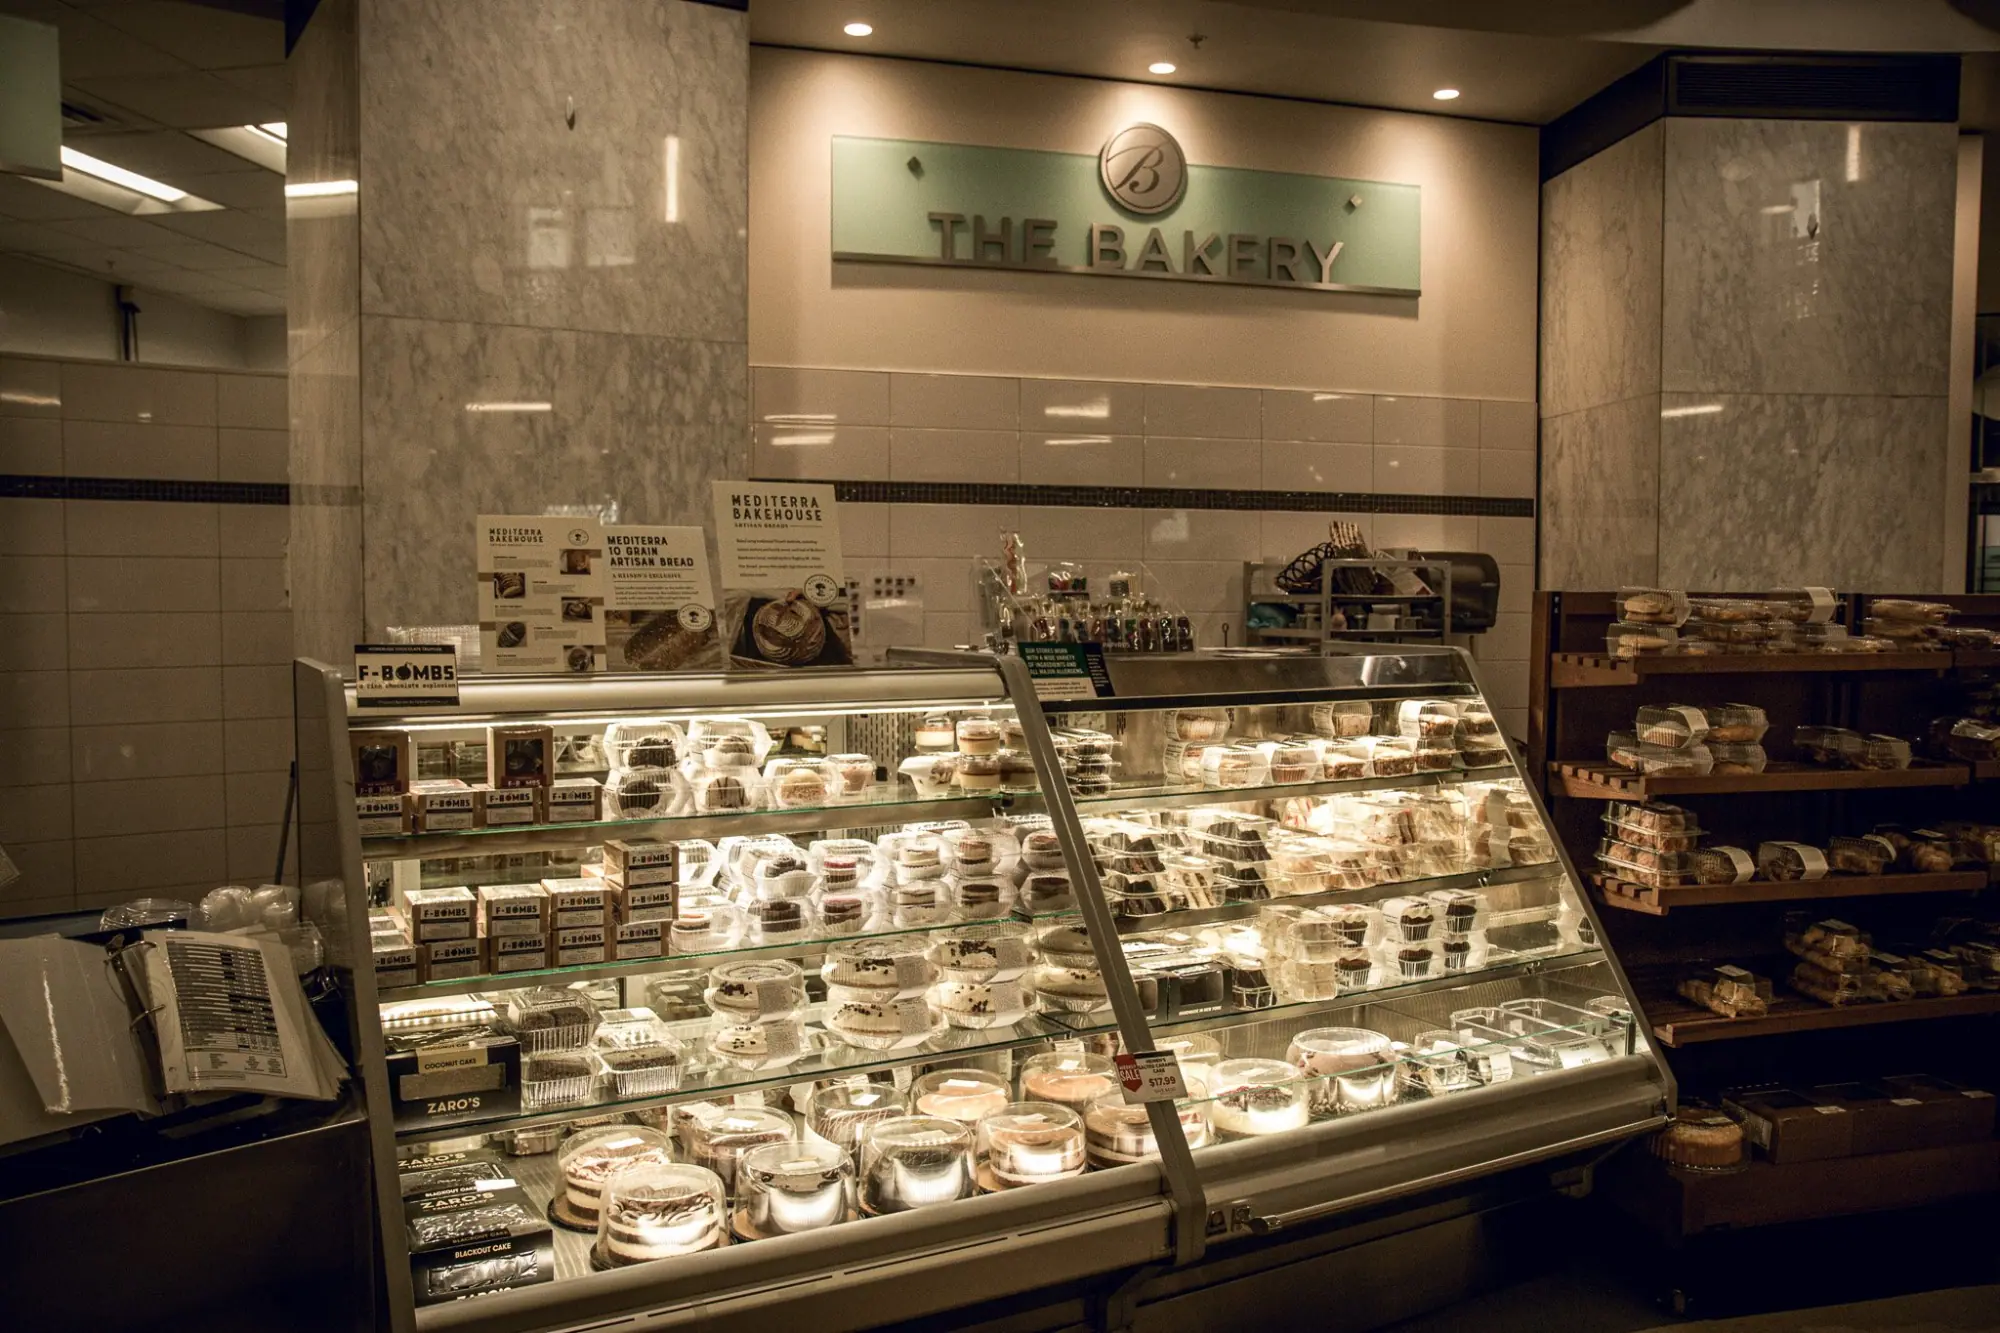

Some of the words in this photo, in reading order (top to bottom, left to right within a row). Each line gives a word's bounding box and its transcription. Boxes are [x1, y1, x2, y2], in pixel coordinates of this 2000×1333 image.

[927, 212, 1058, 266] THE
[1090, 221, 1345, 286] BAKERY
[732, 494, 819, 508] MEDITERRA
[733, 508, 822, 521] BAKEHOUSE
[489, 527, 542, 536] MEDITERRA
[489, 535, 544, 543] BAKEHOUSE
[607, 535, 668, 546] MEDITERRA
[626, 546, 658, 556] GRAIN
[610, 557, 655, 567] ARTISAN
[660, 557, 694, 567] BREAD
[358, 663, 454, 680] F-BOMBS
[489, 792, 530, 802] F-BOMBS
[430, 799, 471, 807] F-BOMBS
[632, 853, 670, 864] F-BOMBS
[560, 896, 600, 906] F-BOMBS
[424, 908, 467, 918] F-BOMBS
[495, 905, 537, 914] F-BOMBS
[620, 928, 659, 938] F-BOMBS
[562, 934, 602, 943] F-BOMBS
[502, 940, 542, 950] F-BOMBS
[434, 946, 477, 958] F-BOMBS
[376, 955, 411, 964] -BOMBS
[424, 1060, 459, 1070] COCONUT
[1120, 1069, 1140, 1081] SALE
[1149, 1076, 1176, 1088] $17.99
[427, 1096, 481, 1114] ZARO'S
[397, 1152, 466, 1167] ZARO'S
[425, 1187, 459, 1197] BLACKOUT
[420, 1192, 495, 1210] ZARO'S
[460, 1199, 488, 1208] BAKERY
[452, 1233, 489, 1244] BLACKOUT
[489, 1230, 510, 1239] CAKE
[455, 1245, 492, 1259] BLACKOUT
[492, 1242, 511, 1252] CAKE
